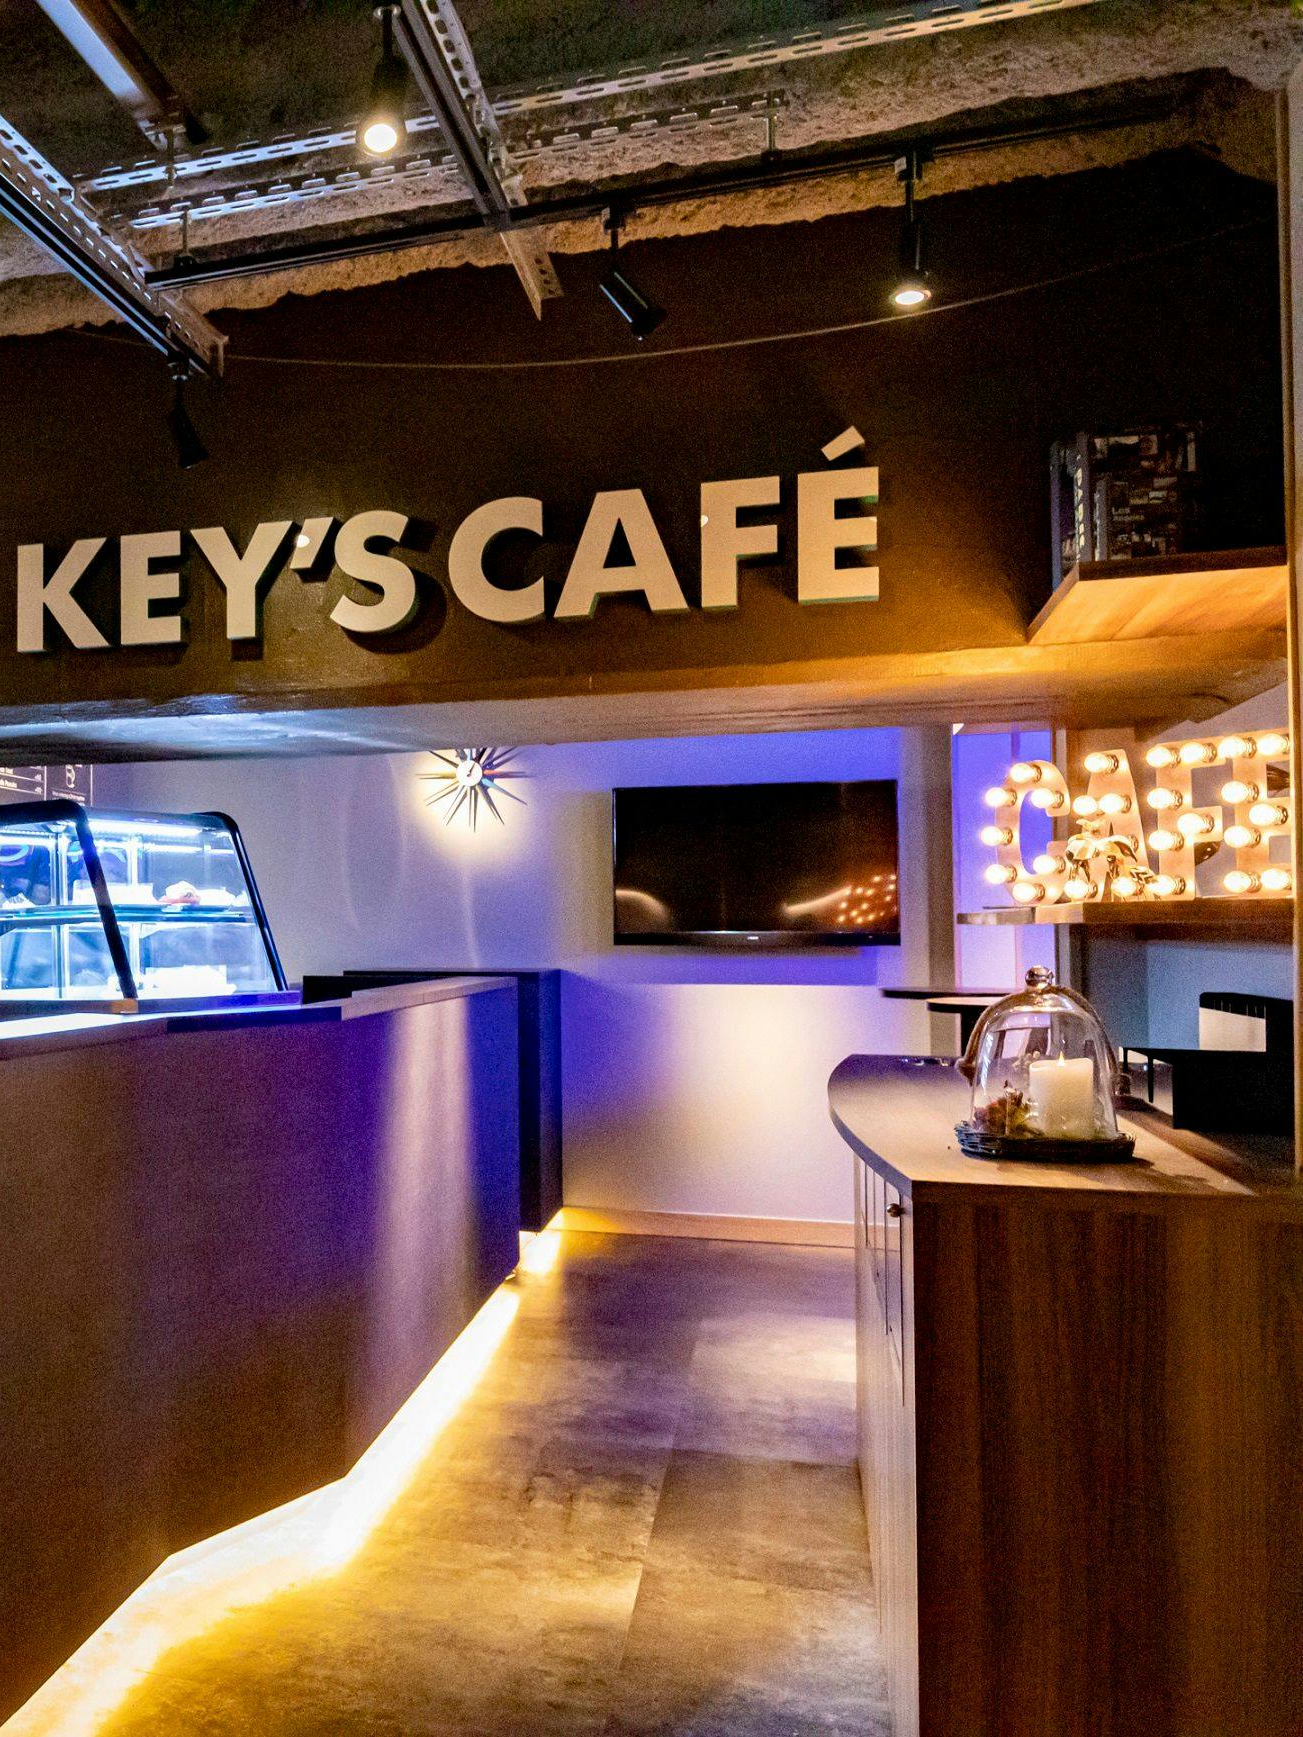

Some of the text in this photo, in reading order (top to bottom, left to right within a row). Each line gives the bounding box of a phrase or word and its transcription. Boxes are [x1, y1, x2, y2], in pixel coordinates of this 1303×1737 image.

[16, 425, 882, 653] KEY'S CAFÉ
[984, 734, 1292, 905] CAFE
